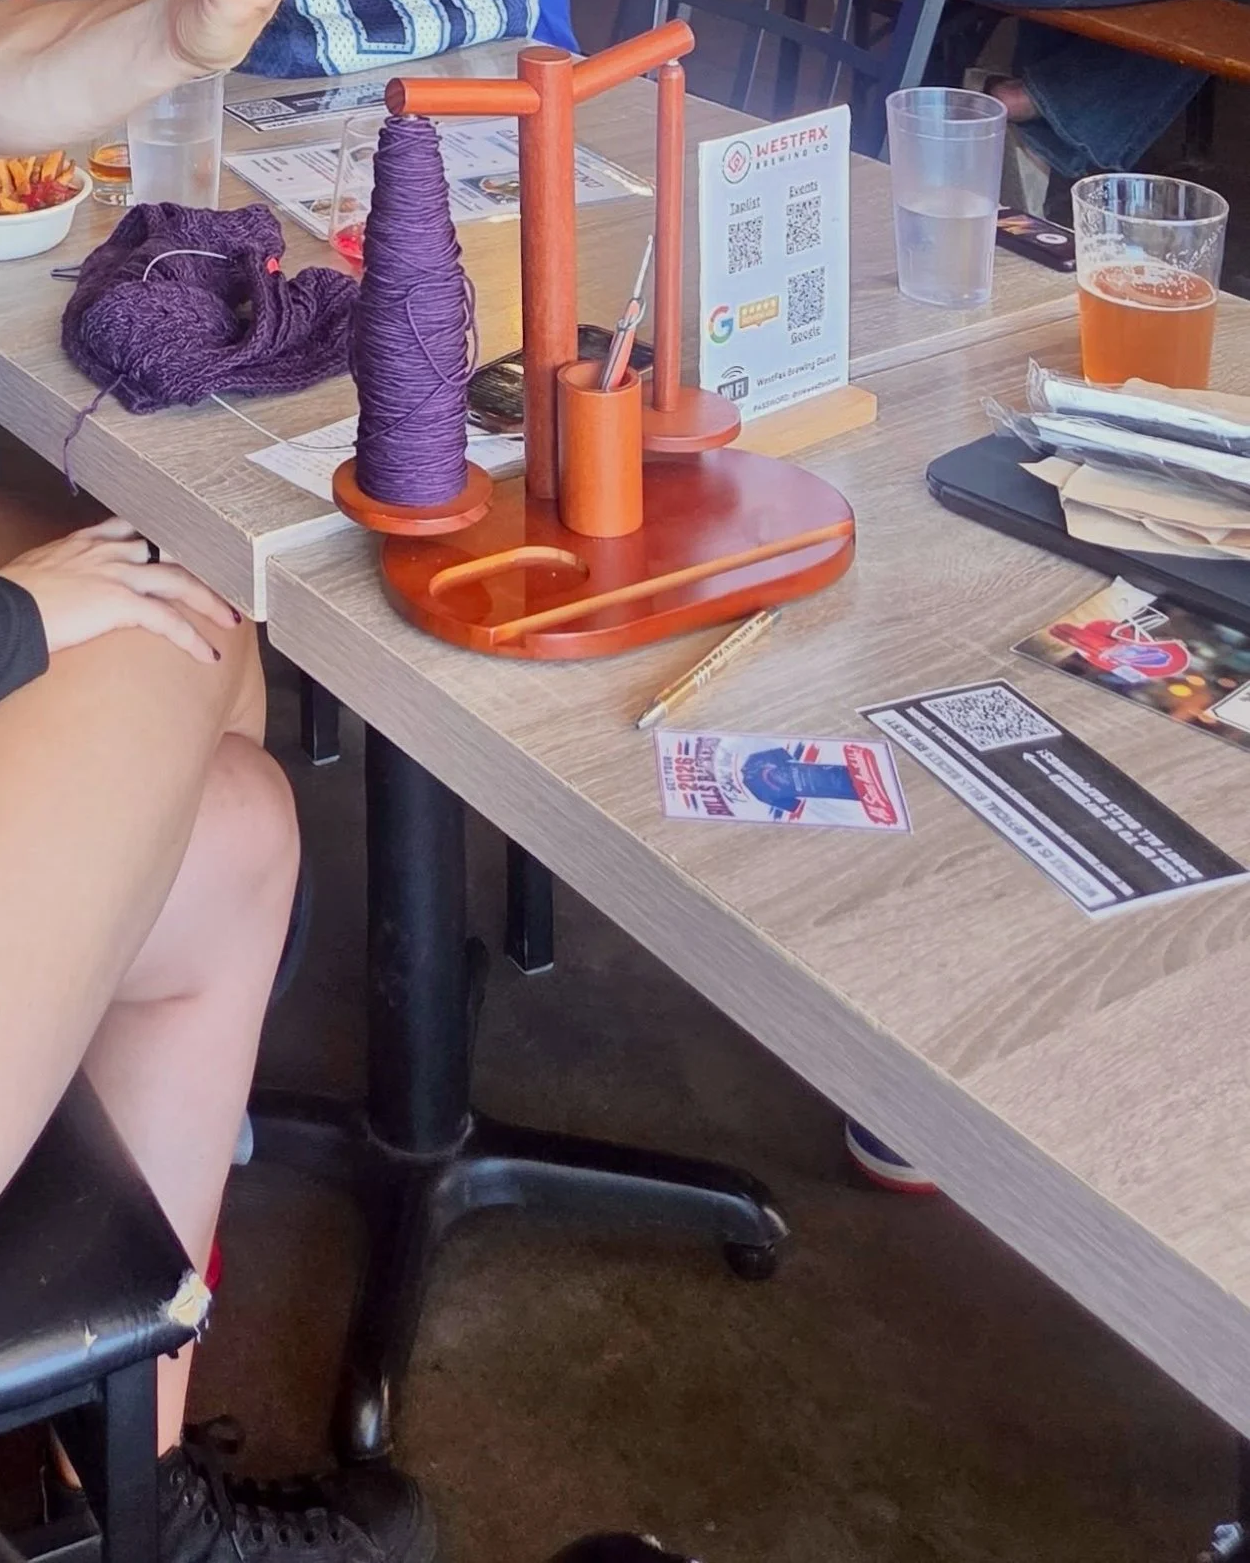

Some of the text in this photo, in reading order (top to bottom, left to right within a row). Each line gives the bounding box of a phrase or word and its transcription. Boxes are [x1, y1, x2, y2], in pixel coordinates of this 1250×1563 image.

[756, 124, 829, 157] WESTFAX
[756, 142, 829, 170] BREWING CO
[789, 180, 819, 198] Events
[730, 196, 761, 215] Taplist
[674, 756, 699, 792] 2026
[697, 782, 735, 817] BILLS
